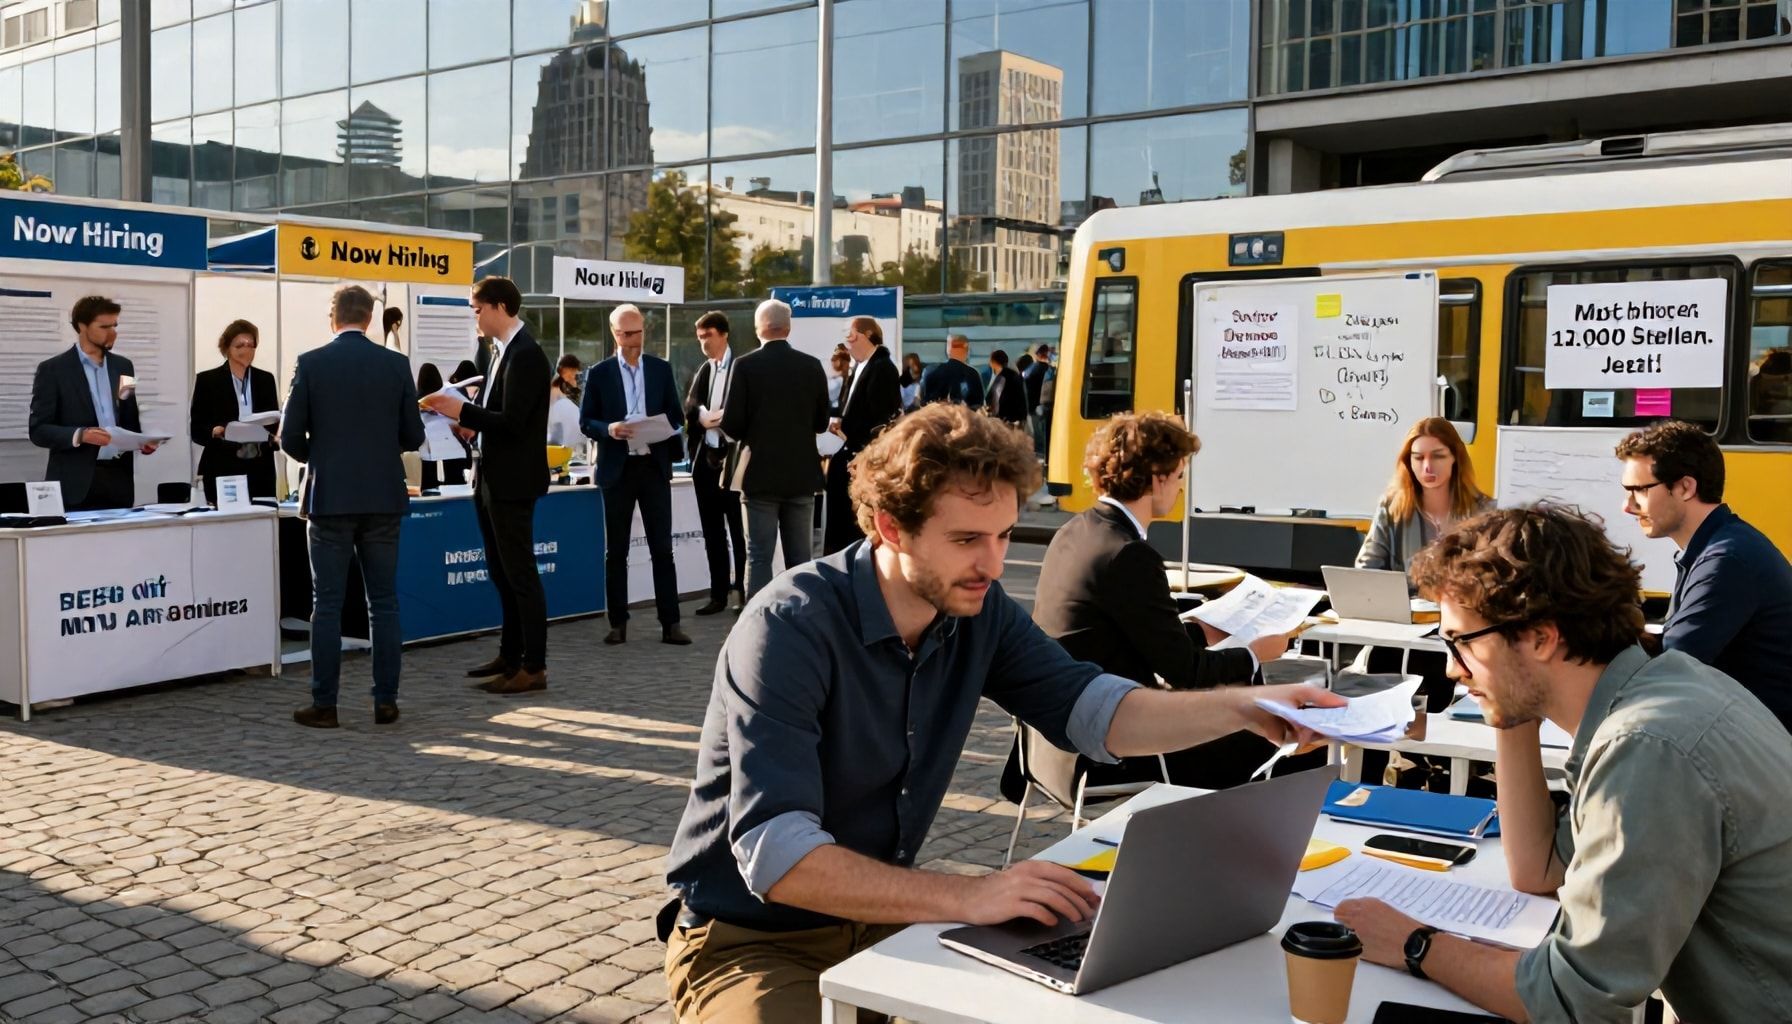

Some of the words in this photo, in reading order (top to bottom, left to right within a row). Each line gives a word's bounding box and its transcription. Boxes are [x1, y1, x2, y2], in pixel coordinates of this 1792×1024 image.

[13, 215, 77, 245] Now
[83, 221, 164, 258] Hiring
[331, 240, 382, 266] Now
